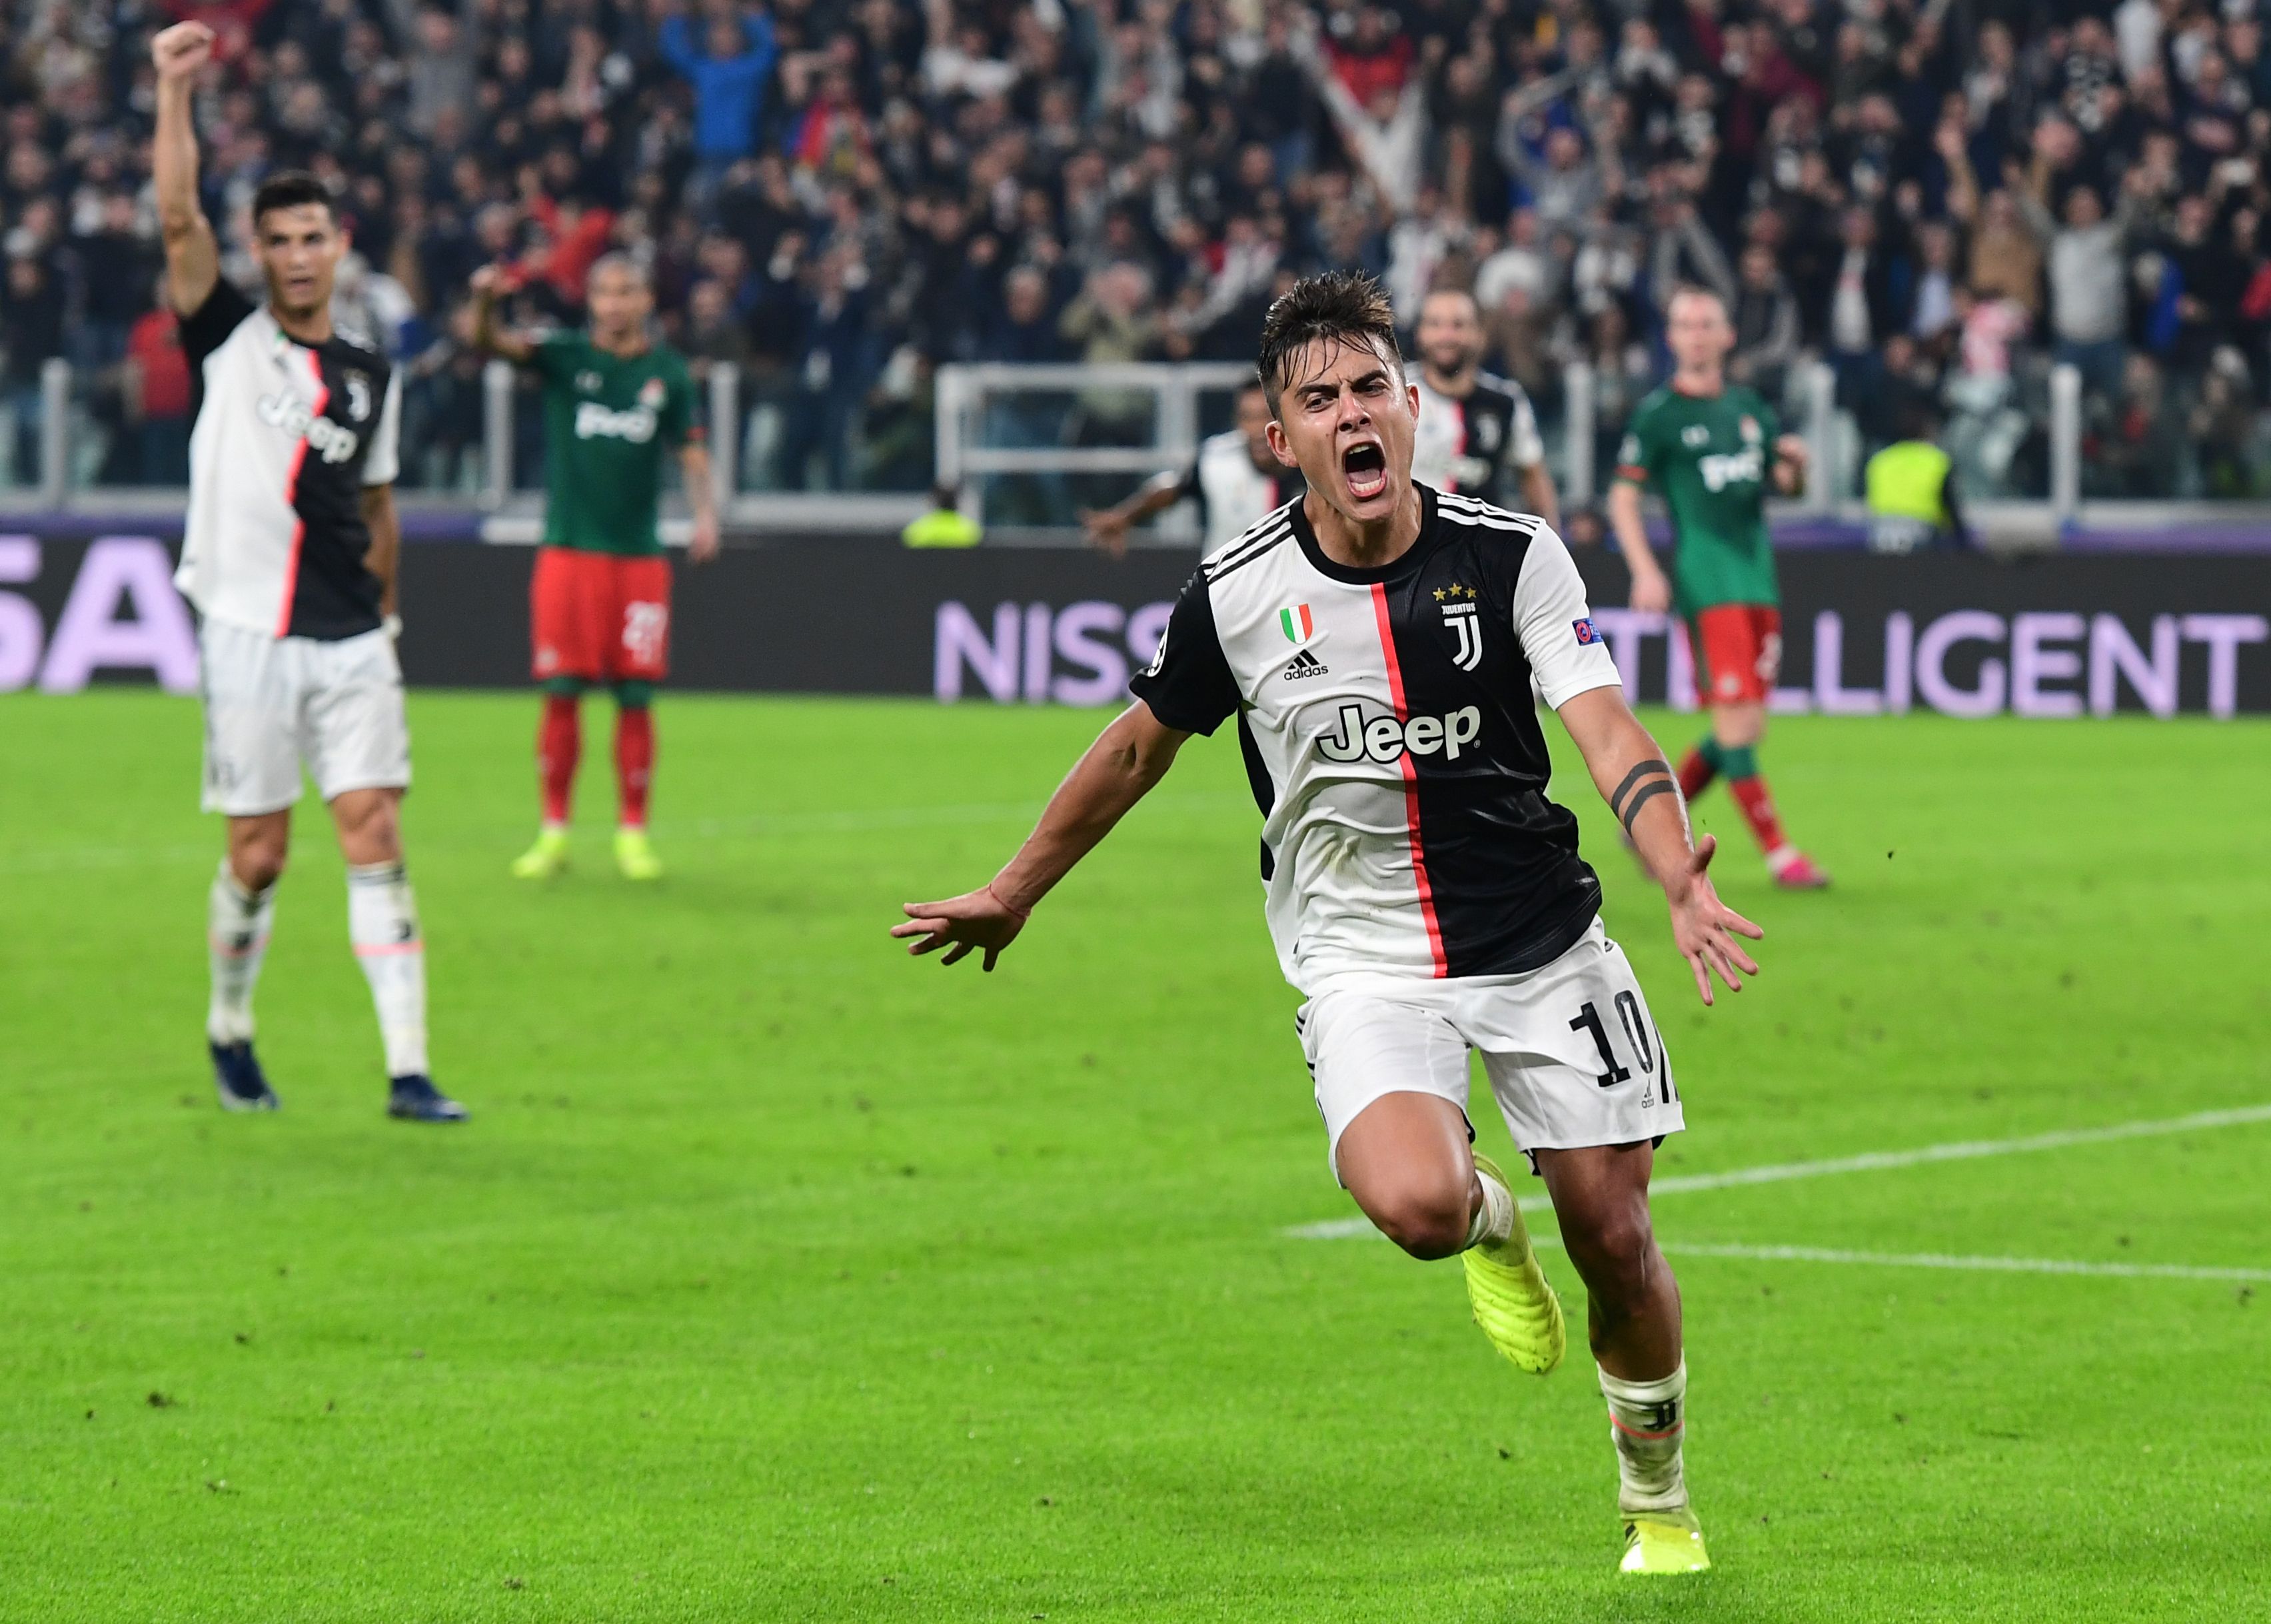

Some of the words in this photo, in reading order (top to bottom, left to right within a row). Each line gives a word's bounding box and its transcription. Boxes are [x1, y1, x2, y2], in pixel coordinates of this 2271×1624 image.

[256, 387, 360, 464] Jeep
[1441, 602, 1476, 614] JUVENTUS
[1283, 665, 1329, 681] adidas
[1590, 606, 2269, 723] TLIGENT
[1315, 704, 1481, 764] Jeep
[1569, 990, 1654, 1088] 10
